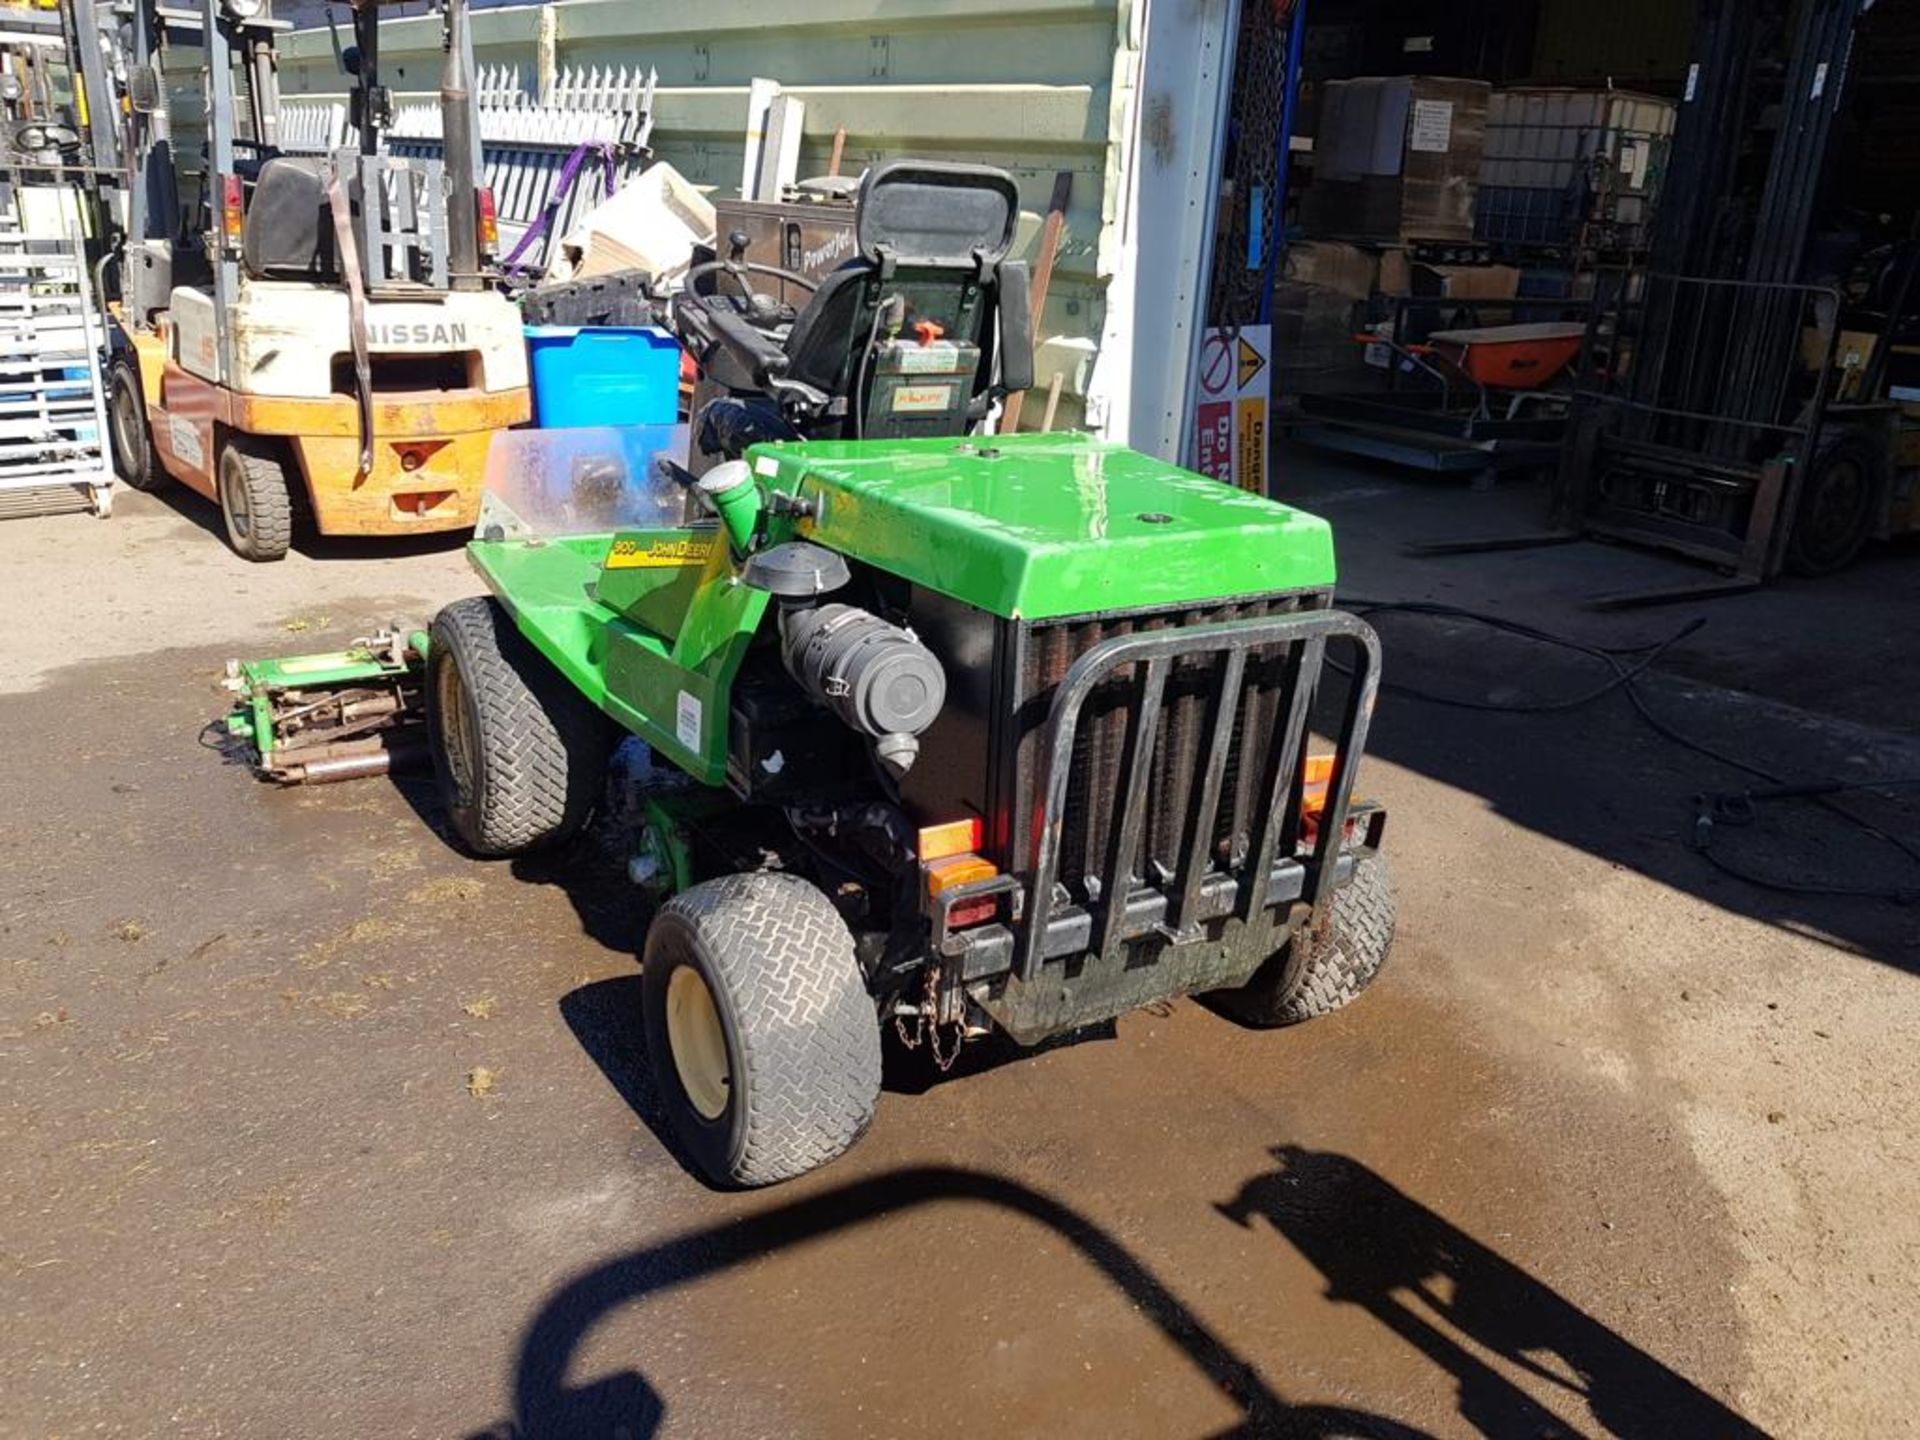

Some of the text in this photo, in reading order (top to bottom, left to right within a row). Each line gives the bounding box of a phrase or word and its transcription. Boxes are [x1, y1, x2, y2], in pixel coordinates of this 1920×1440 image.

[367, 322, 467, 344] NISSAN
[1201, 428, 1214, 476] Ent
[1217, 415, 1229, 453] Do
